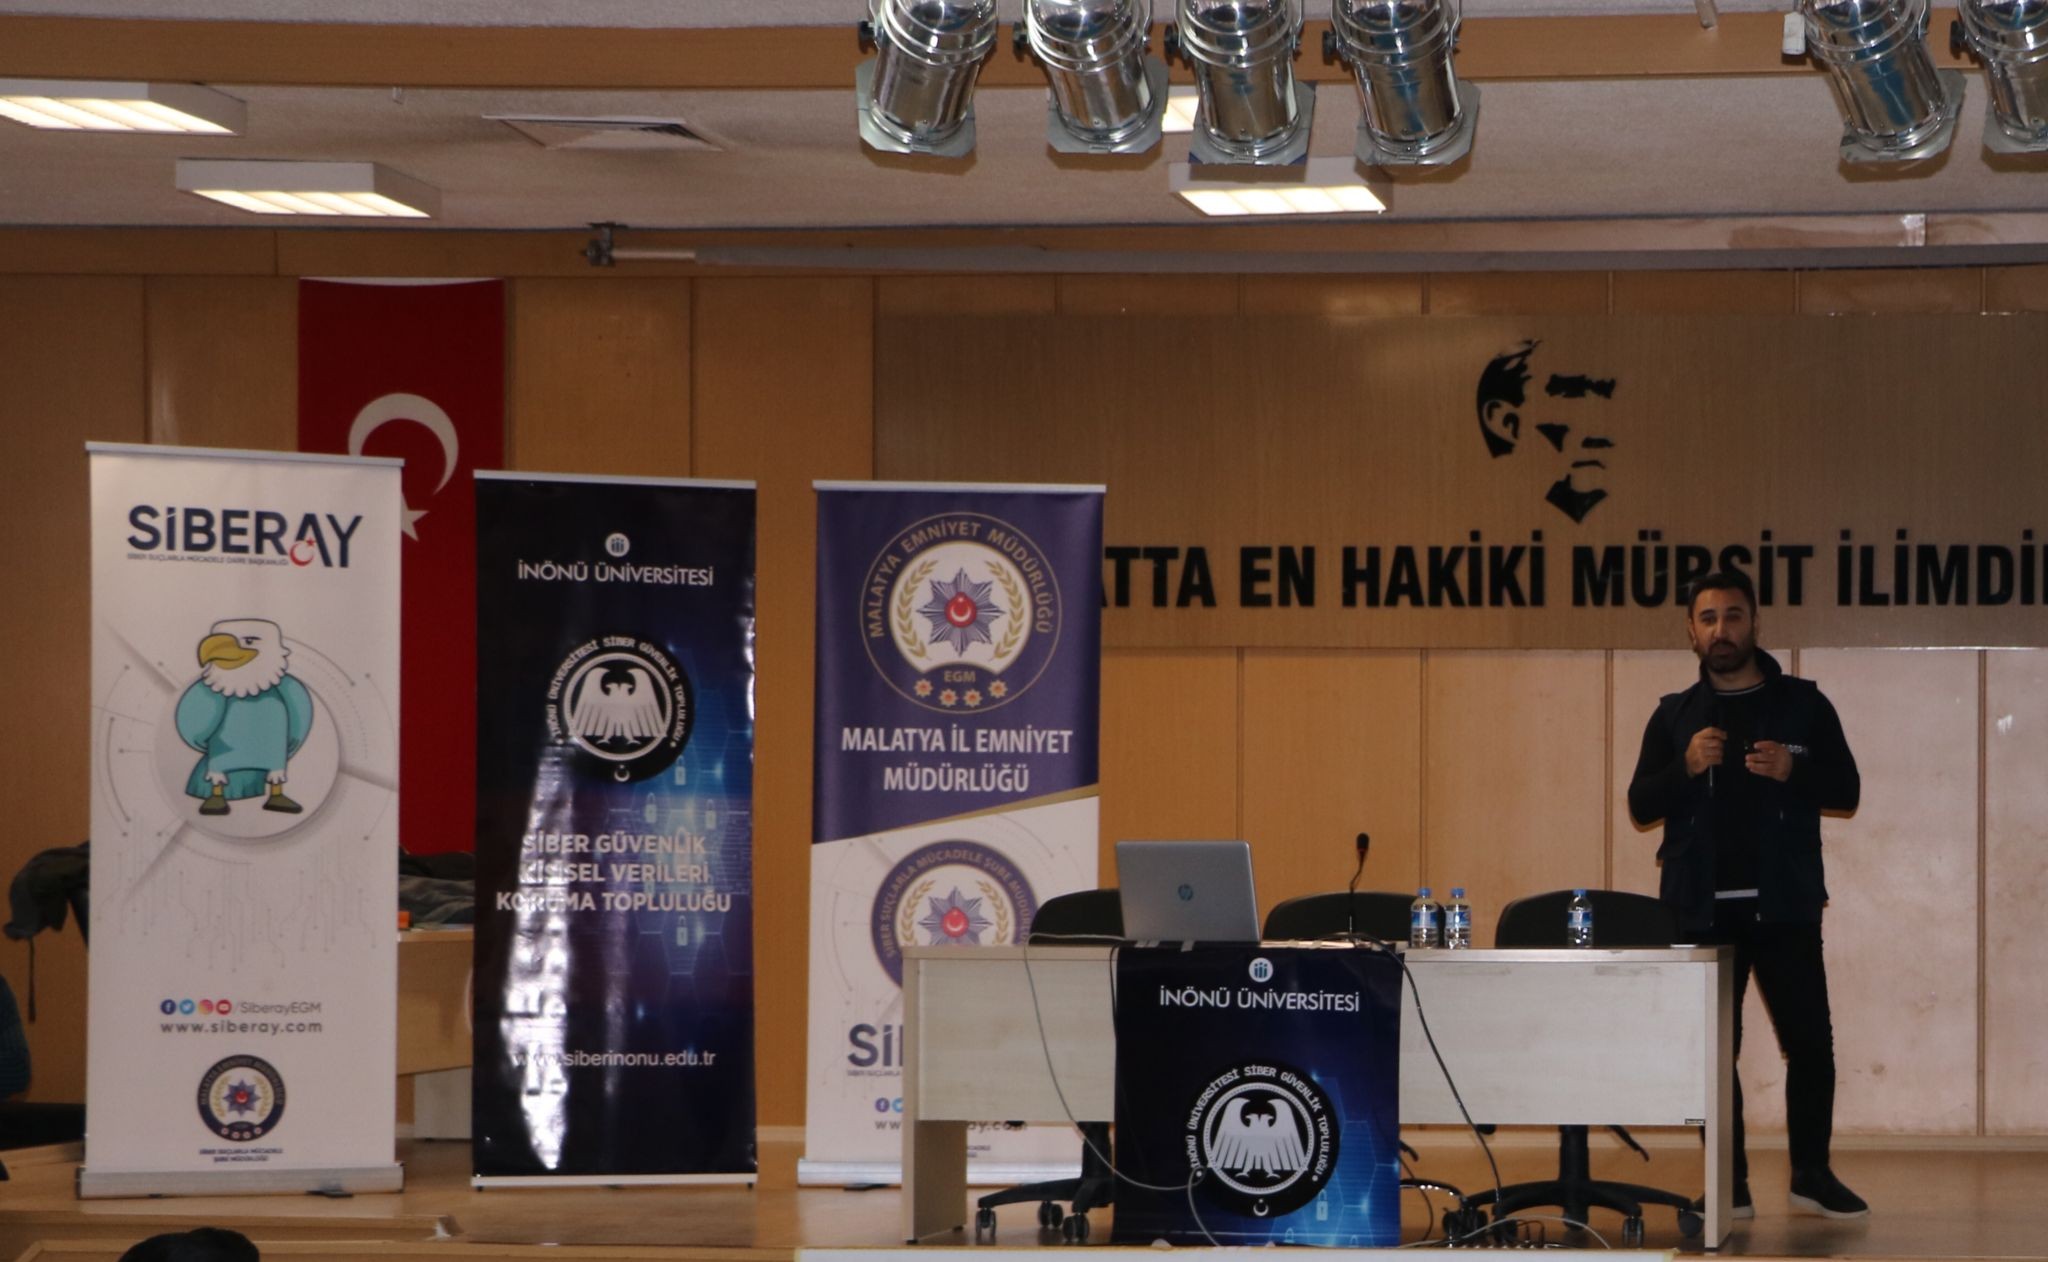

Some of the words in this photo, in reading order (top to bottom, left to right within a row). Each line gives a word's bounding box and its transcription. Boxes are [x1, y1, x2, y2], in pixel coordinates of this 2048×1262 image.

[518, 559, 588, 581] İNÖNÜ
[594, 562, 714, 586] ÜNİVERSİTESİ
[869, 554, 902, 638] MALATYA
[902, 519, 981, 553] EMNİYET
[987, 528, 1053, 633] MÜDÜRLÜĞÜ
[1101, 546, 1217, 607] TTA
[1240, 546, 1315, 607] EN
[1342, 529, 1545, 607] HAKİKİ
[944, 671, 976, 682] EGM
[841, 727, 946, 751] MALATYA
[952, 724, 971, 752] İL
[976, 725, 1073, 753] EMNİYET
[883, 762, 1029, 792] MÜDÜRLÜĞÜ
[522, 830, 589, 853] SİBER
[610, 861, 709, 883] VERİLERİ
[603, 886, 731, 912] TOPLULUĞU
[1160, 985, 1230, 1008] İNÖNÜ
[1237, 988, 1360, 1012] ÜNİVERSİTESİ
[160, 1020, 323, 1035] www.siberay.com
[511, 1050, 716, 1067] wsiberinonu.edu.tr
[1244, 1064, 1276, 1078] SİBER
[1280, 1071, 1322, 1112] GÜVENLİK
